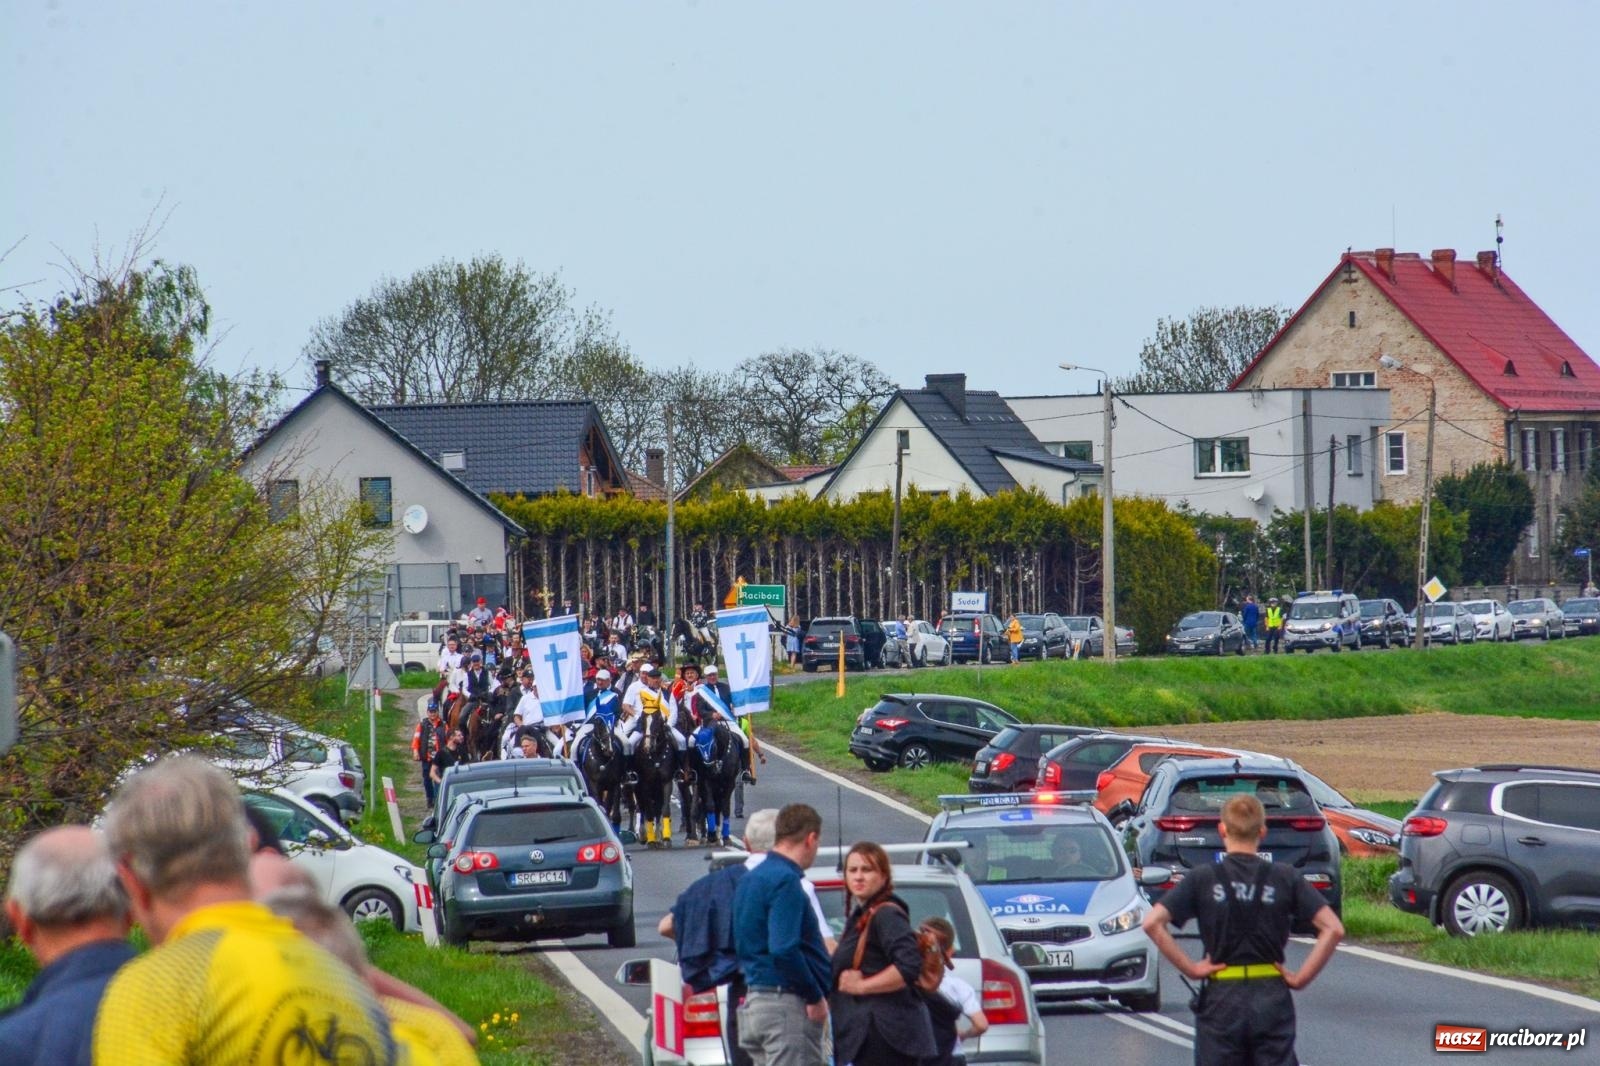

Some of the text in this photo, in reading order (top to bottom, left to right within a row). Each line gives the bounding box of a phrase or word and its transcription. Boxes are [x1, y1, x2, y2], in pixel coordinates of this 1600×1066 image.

[517, 870, 564, 885] SRC PC14
[991, 903, 1071, 916] POLICJA
